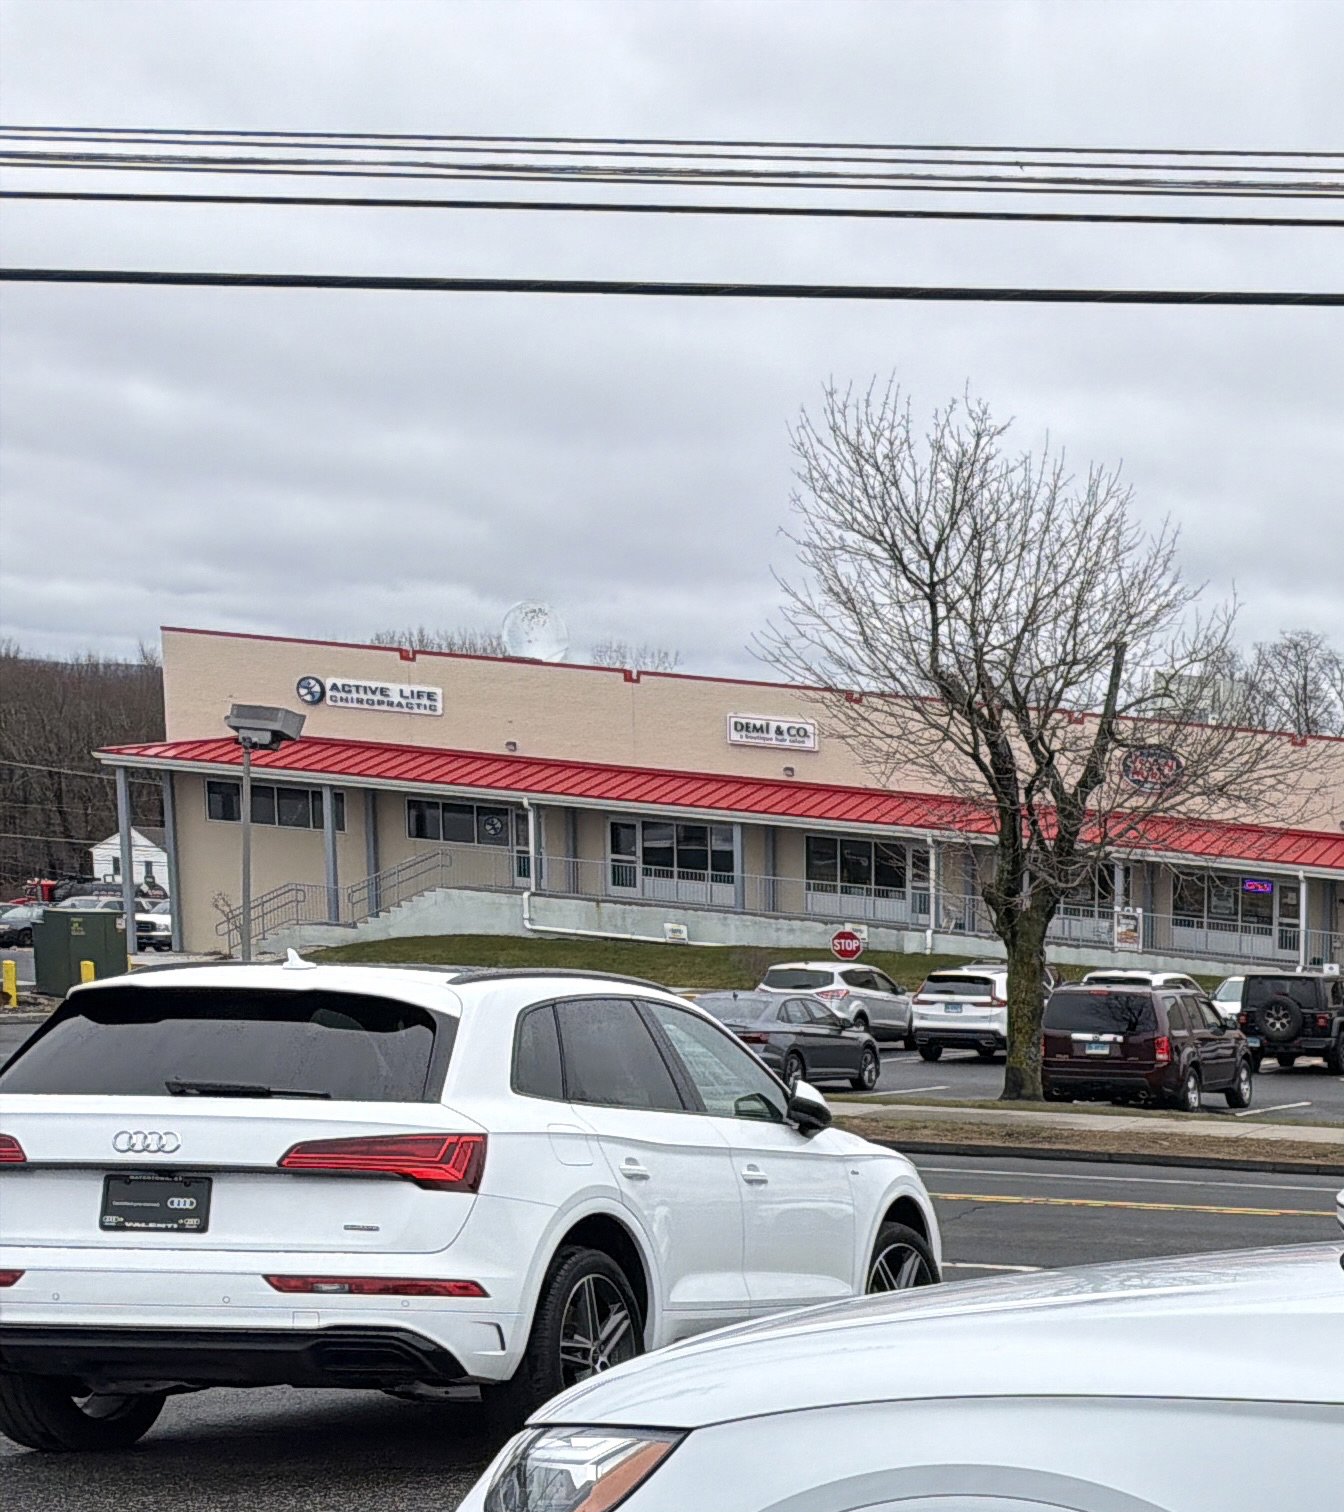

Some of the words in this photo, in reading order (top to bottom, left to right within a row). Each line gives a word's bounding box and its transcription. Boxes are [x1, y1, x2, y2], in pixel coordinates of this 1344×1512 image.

[329, 682, 391, 697] ACTIVE
[399, 687, 438, 701] LIFE
[329, 694, 438, 712] CHIROPRACTIC
[774, 724, 784, 737] &
[833, 939, 860, 951] STOP
